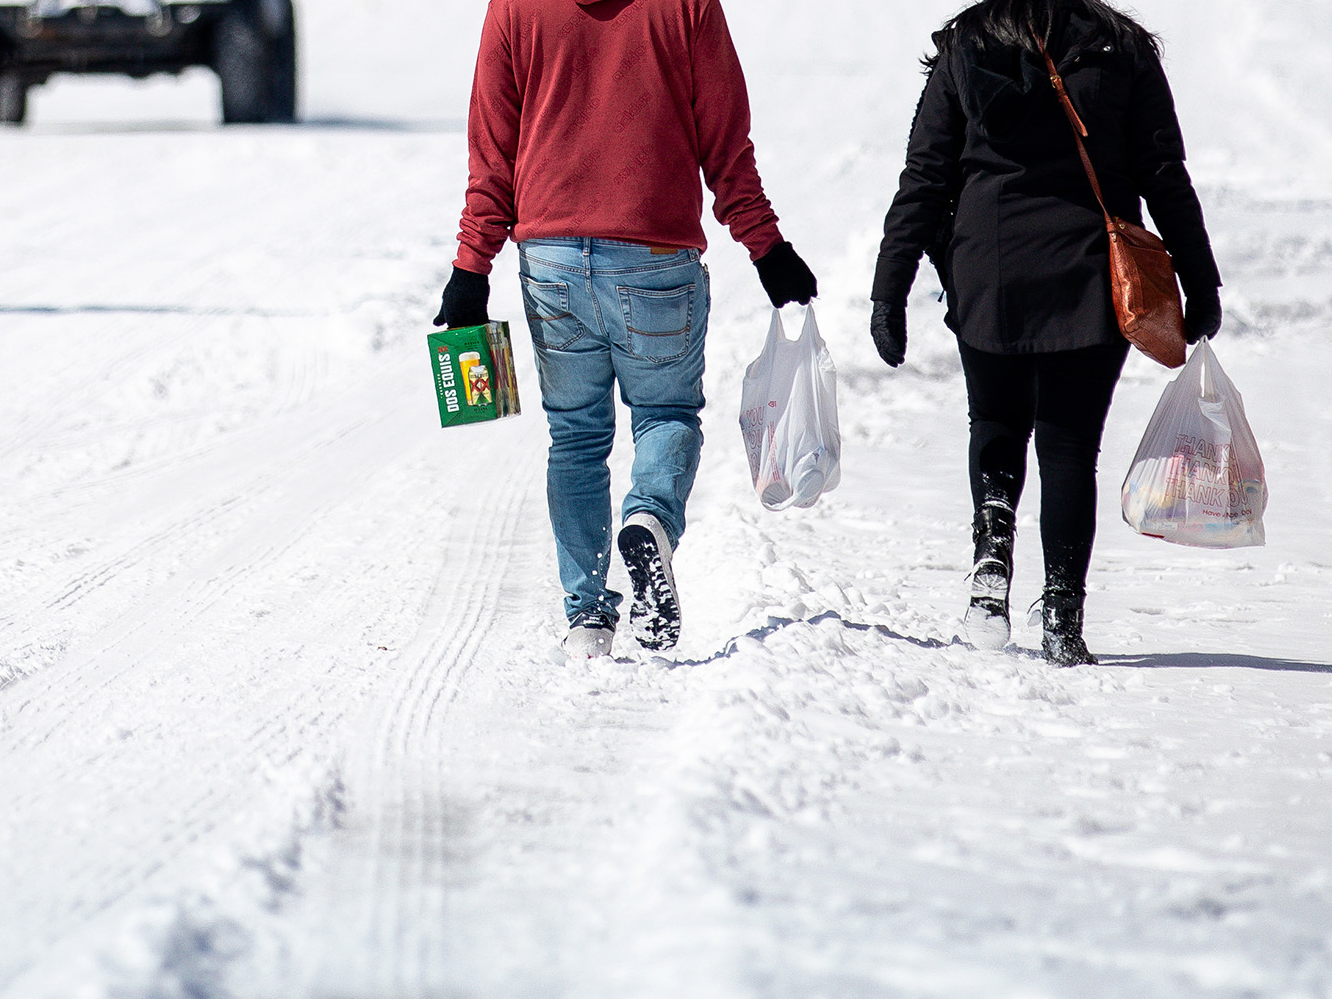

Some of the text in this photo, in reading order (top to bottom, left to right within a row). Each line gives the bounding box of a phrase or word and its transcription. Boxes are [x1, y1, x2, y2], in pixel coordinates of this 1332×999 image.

[555, 8, 586, 41] idas
[612, 90, 652, 134] adidas
[612, 143, 654, 186] adidas
[438, 353, 460, 413] DOS EQUIS
[1165, 477, 1225, 507] THANK
